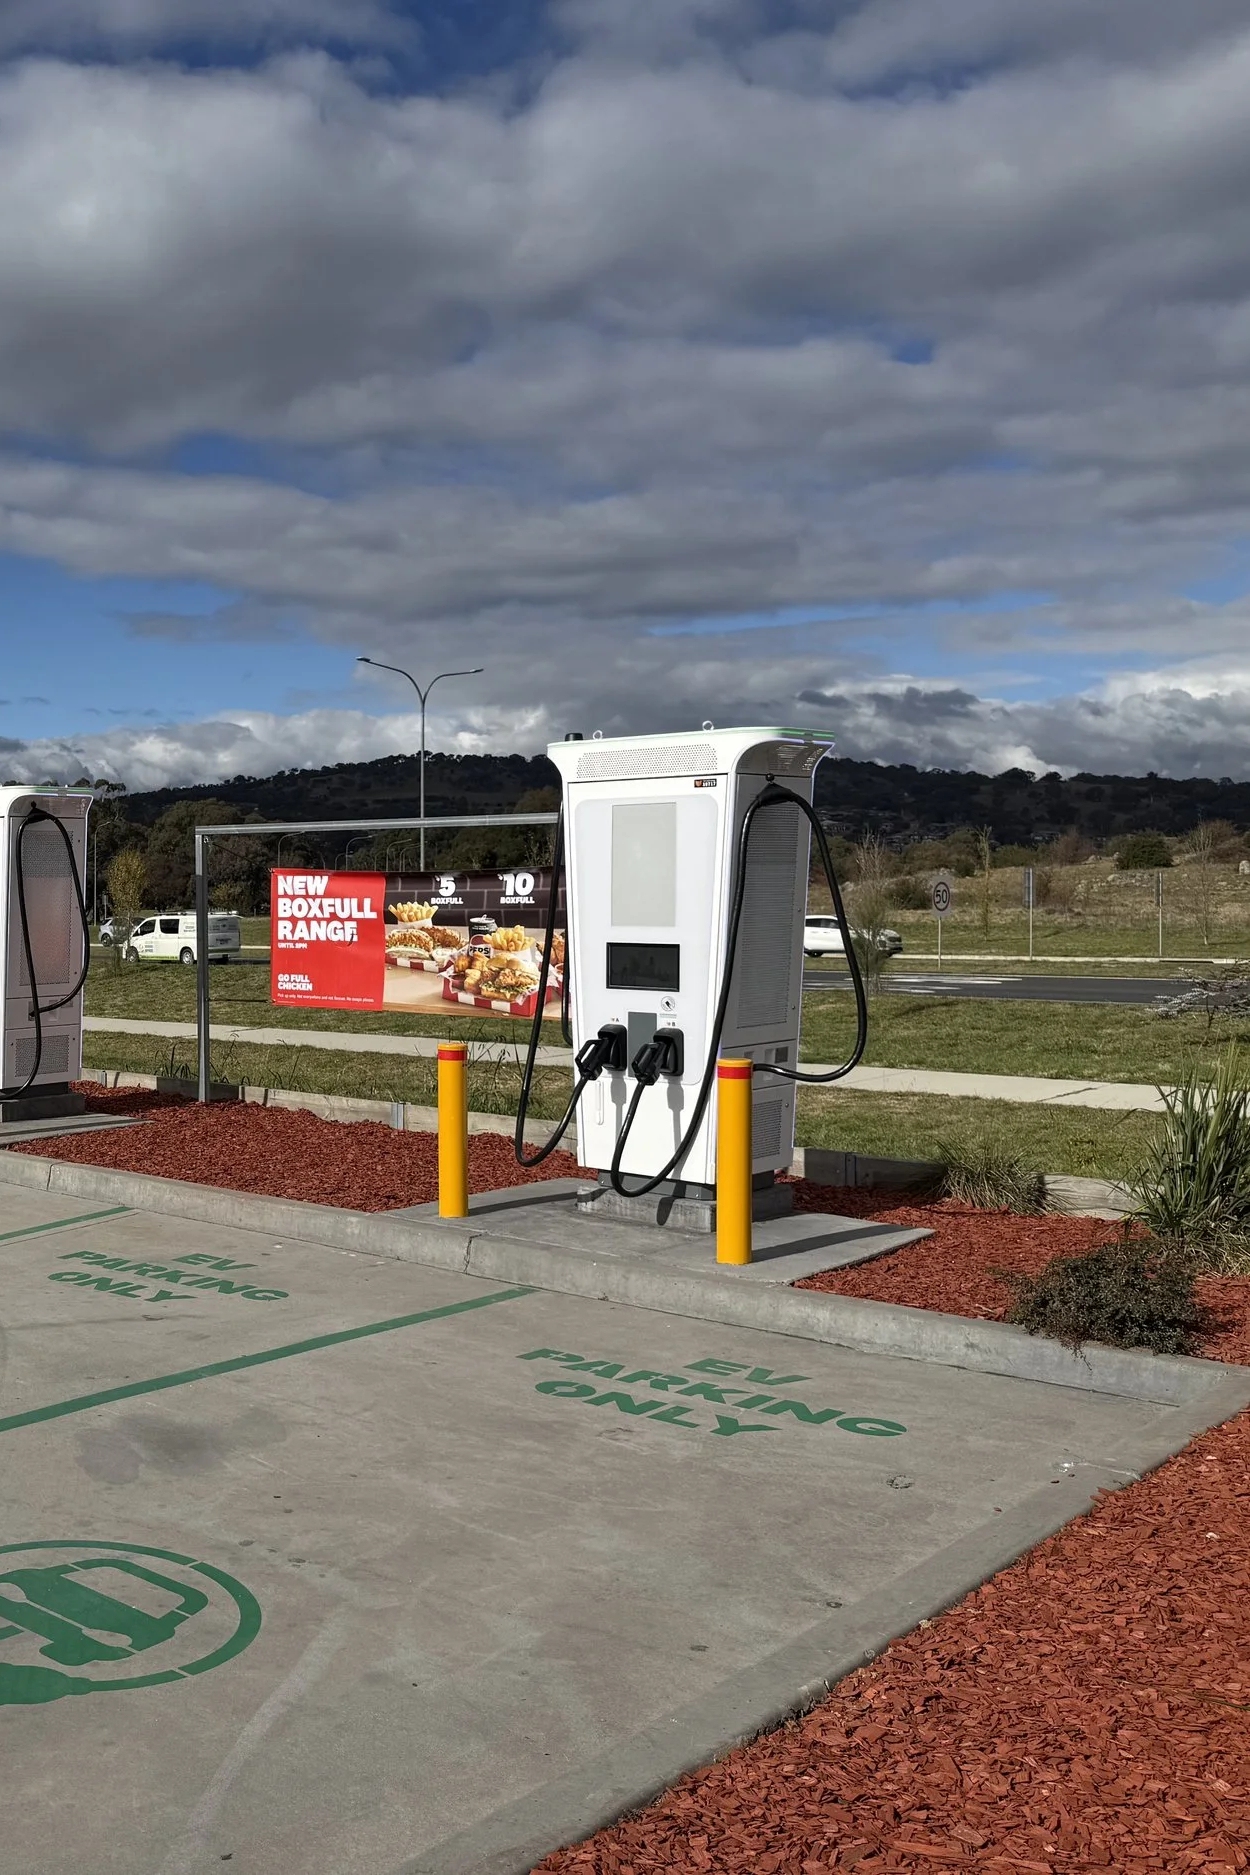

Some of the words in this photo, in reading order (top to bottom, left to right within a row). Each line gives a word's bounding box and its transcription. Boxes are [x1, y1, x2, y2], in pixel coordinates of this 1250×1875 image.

[278, 875, 329, 896] NEW
[935, 889, 948, 904] 50
[277, 897, 377, 919] BOXFULL
[499, 896, 536, 904] BOXFULL
[277, 920, 358, 942] RANGE
[277, 974, 290, 982] GO
[290, 974, 310, 982] FULL
[277, 982, 313, 991] CHICKEN
[173, 1252, 258, 1271] EV
[48, 1270, 198, 1303] ONLY
[57, 1250, 291, 1302] PARKING
[683, 1357, 814, 1386] EV
[515, 1348, 908, 1437] PARKING
[534, 1380, 782, 1437] ONLY
